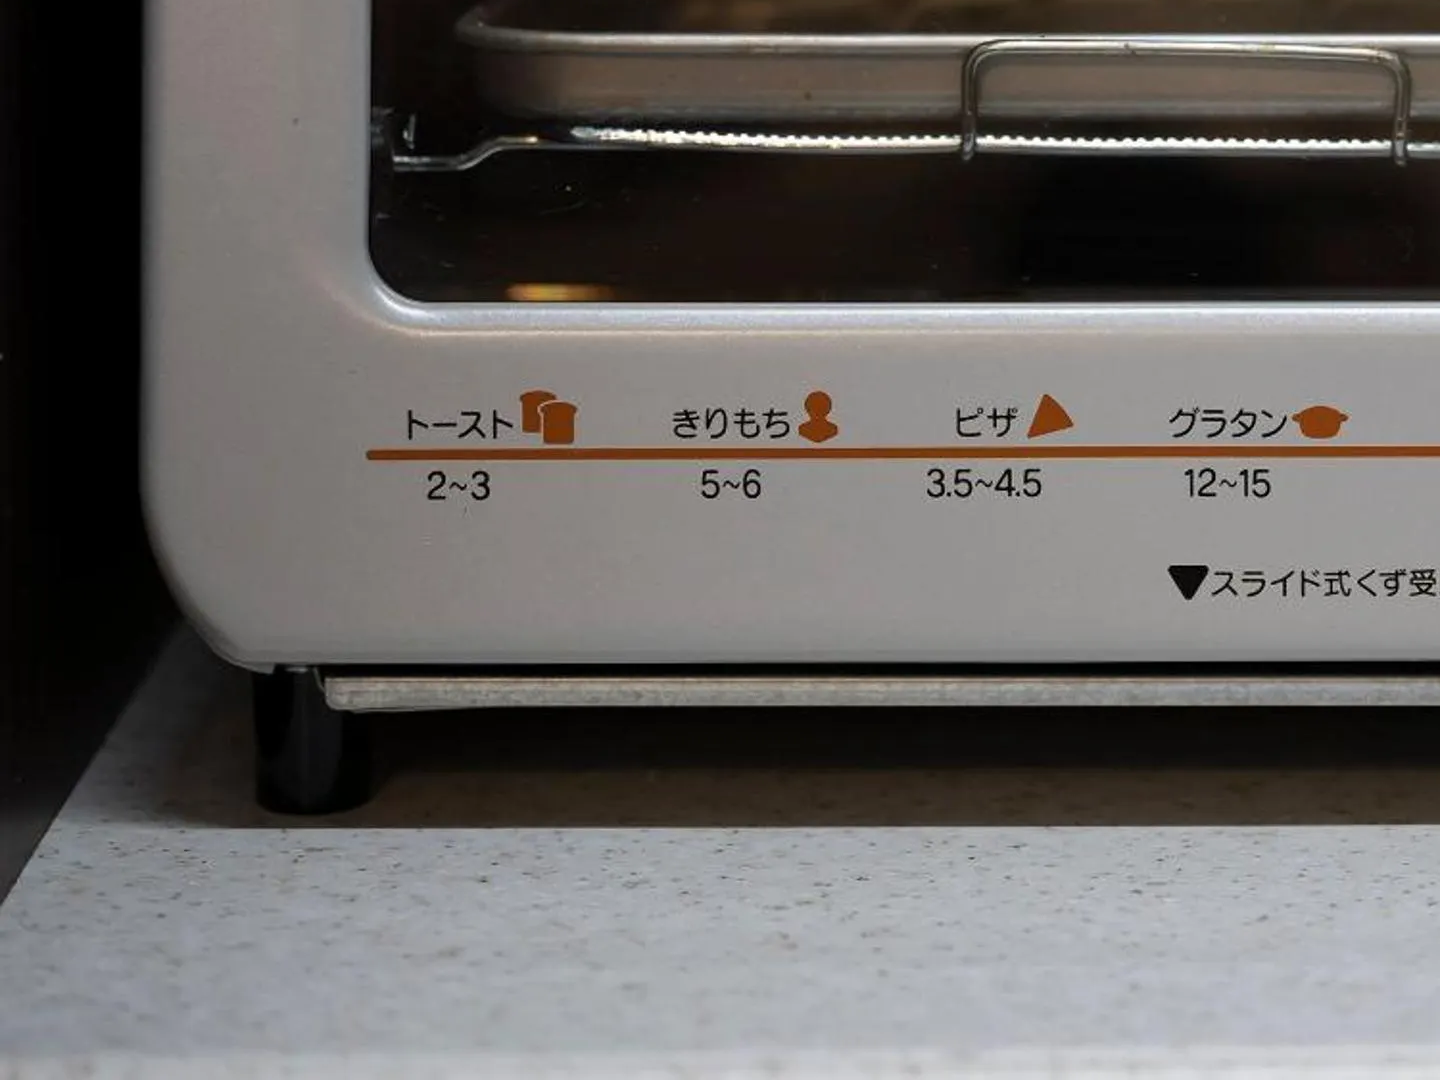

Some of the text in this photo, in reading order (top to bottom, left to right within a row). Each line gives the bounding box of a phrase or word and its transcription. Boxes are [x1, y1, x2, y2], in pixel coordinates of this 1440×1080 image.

[407, 409, 513, 441] トースト
[672, 407, 791, 440] きりもち
[955, 406, 1018, 438] ピザ
[1168, 406, 1288, 439] グラタン
